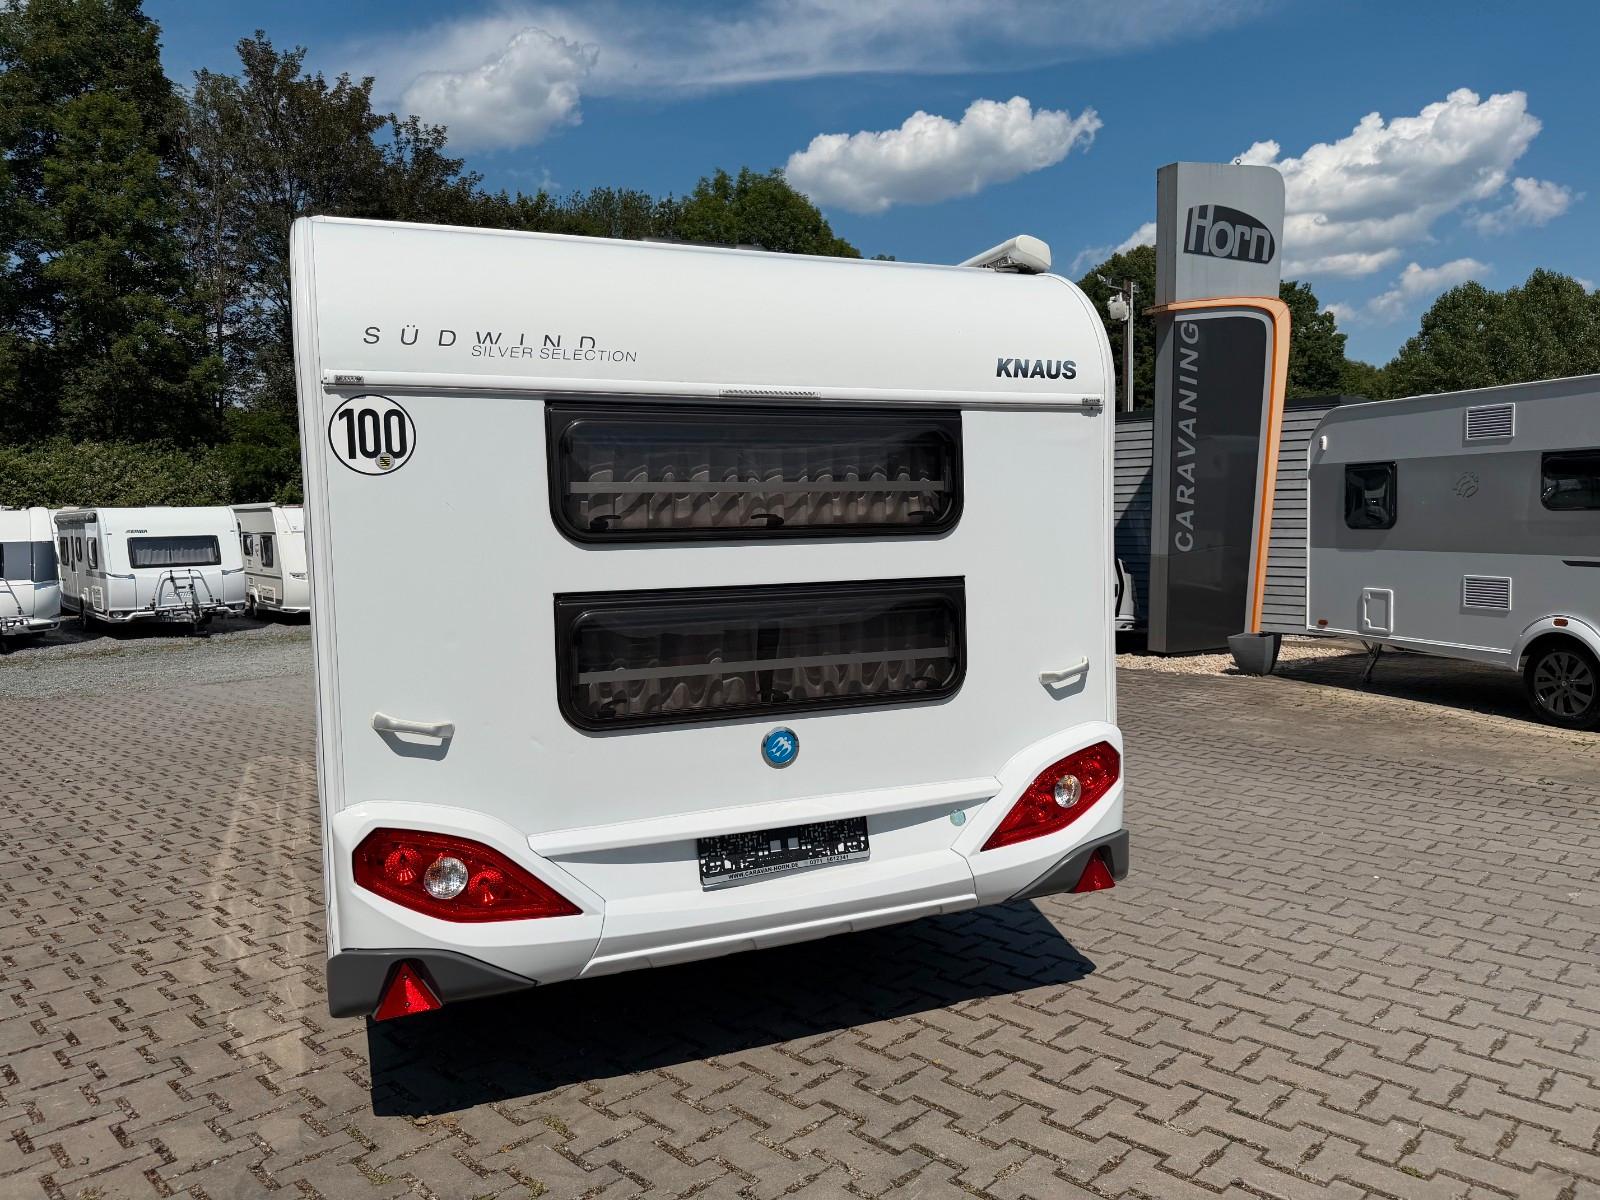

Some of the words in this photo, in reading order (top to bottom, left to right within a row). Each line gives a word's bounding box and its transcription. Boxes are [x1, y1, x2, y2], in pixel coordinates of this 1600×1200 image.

[1187, 204, 1271, 261] Horn
[471, 345, 533, 359] SILVER
[539, 347, 637, 363] SELECTION
[996, 358, 1077, 380] KNAUS
[338, 408, 408, 460] 100
[1174, 321, 1200, 552] CARAVANING
